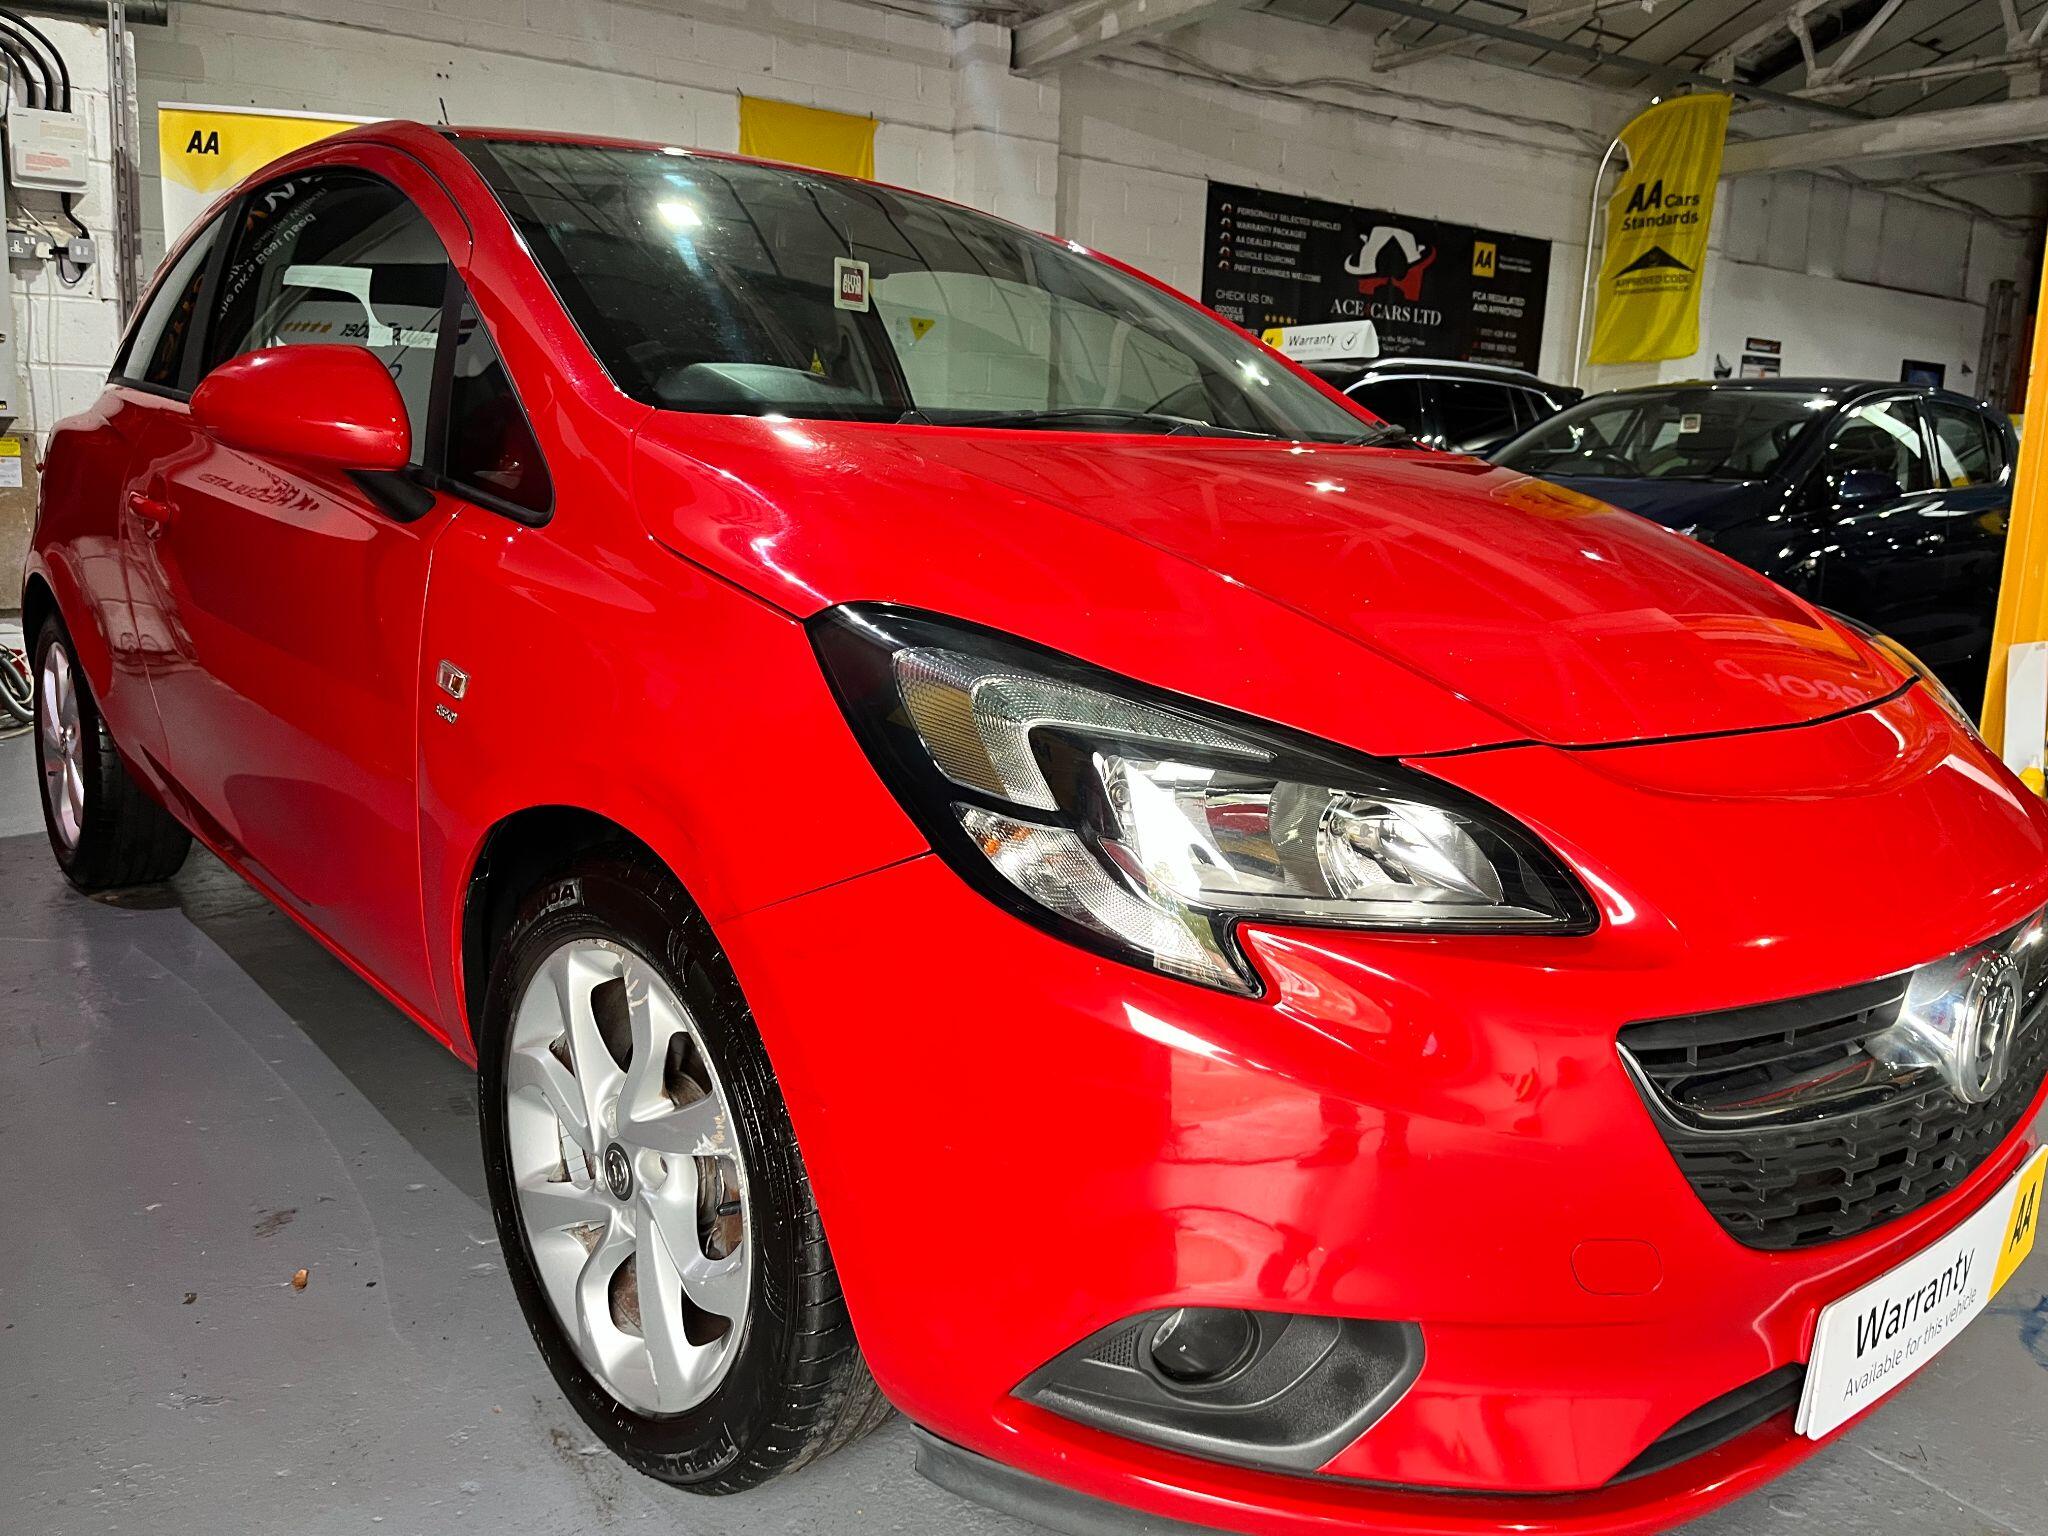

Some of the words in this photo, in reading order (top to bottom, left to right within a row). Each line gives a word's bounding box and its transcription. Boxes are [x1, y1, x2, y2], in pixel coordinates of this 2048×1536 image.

[186, 130, 219, 155] AA
[1625, 179, 1663, 214] AA
[1665, 193, 1700, 208] Cars
[1236, 221, 1272, 234] WARRANTY
[1621, 211, 1699, 231] Standards
[1246, 237, 1271, 248] DEALER
[1235, 250, 1262, 261] VEHICLE
[1263, 252, 1296, 265] SOURCING
[1474, 249, 1493, 269] AA
[1234, 263, 1251, 273] PART
[843, 273, 861, 284] AUTO
[842, 281, 862, 295] GLYM
[1215, 289, 1246, 301] CHECK
[1247, 293, 1260, 303] US
[1261, 295, 1274, 305] ON
[1215, 304, 1243, 315] GOOGLE
[1330, 299, 1364, 317] ACE
[1370, 302, 1411, 322] CARS
[1413, 308, 1442, 326] LTD
[1289, 333, 1336, 347] Warranty
[2008, 1180, 2038, 1254] AA
[1855, 1247, 1975, 1360] Warranty
[1843, 1347, 1903, 1402] Available
[1905, 1333, 1922, 1360] for
[1923, 1317, 1943, 1345] this
[1944, 1287, 1978, 1326] vehicle
